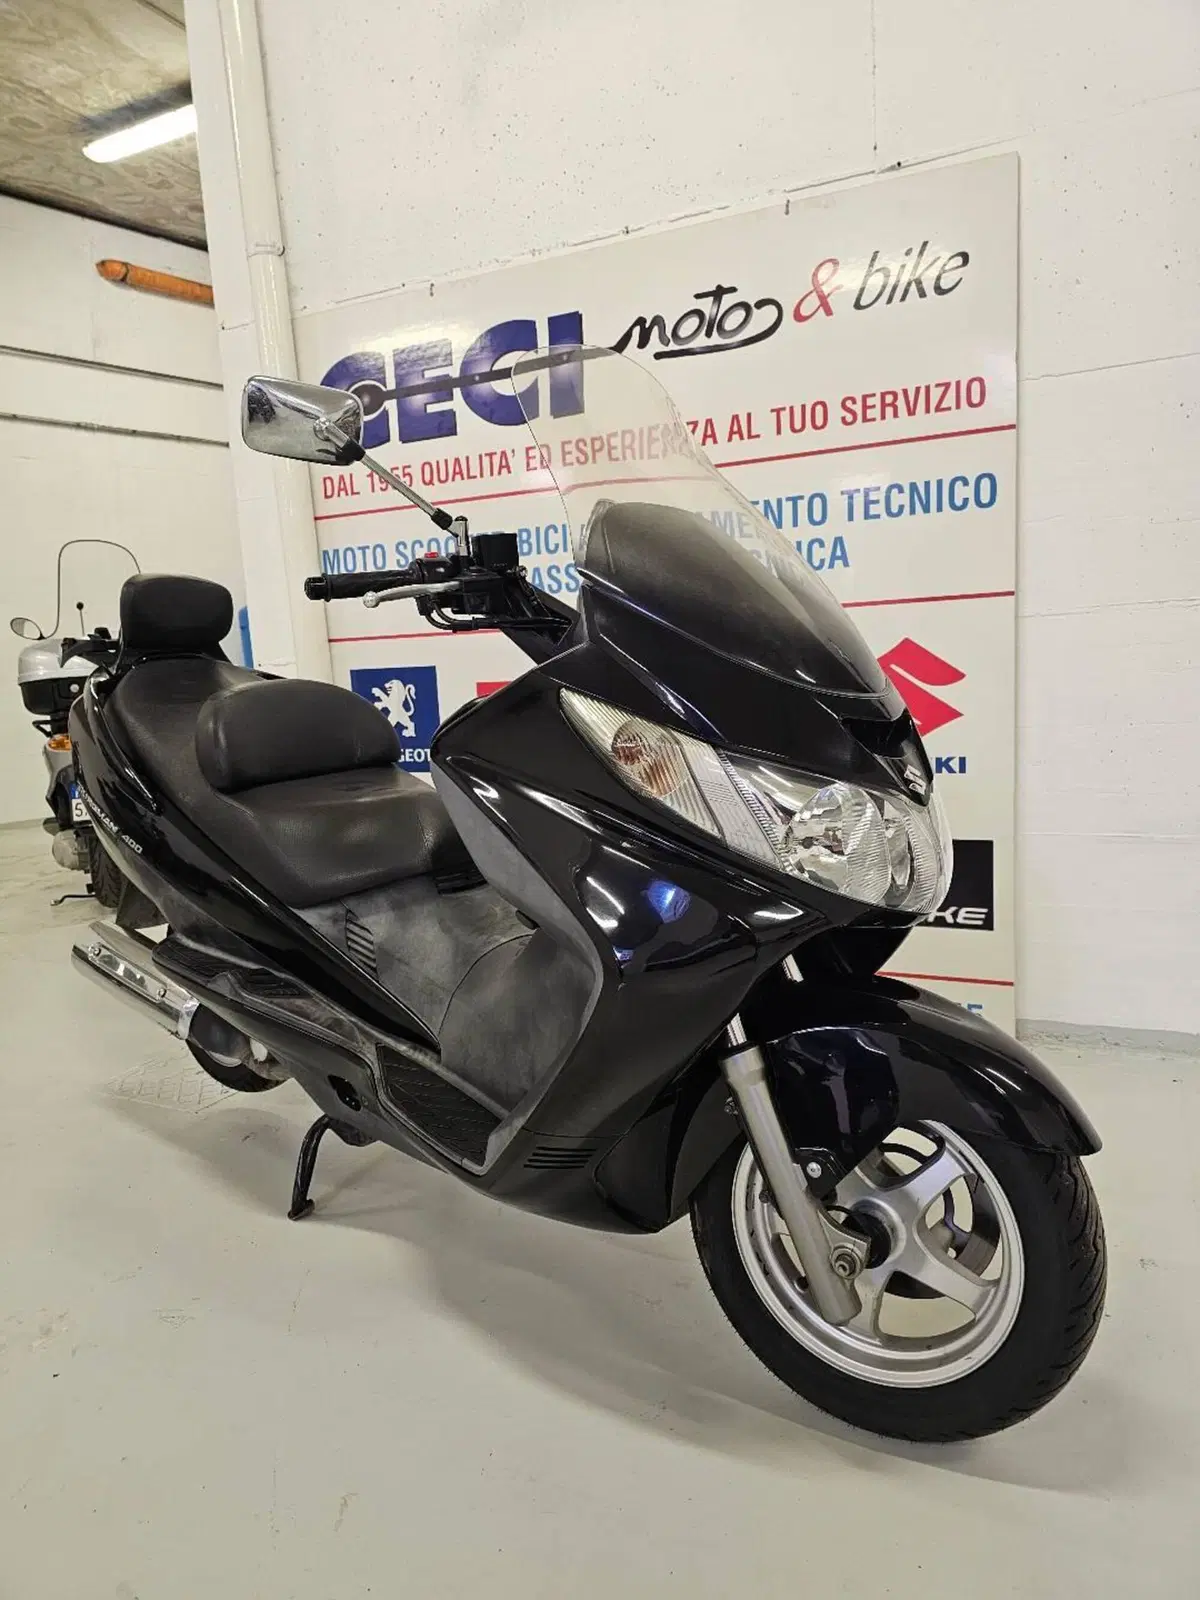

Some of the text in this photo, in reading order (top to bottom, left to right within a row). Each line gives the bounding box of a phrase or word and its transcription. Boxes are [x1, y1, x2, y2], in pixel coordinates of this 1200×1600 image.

[320, 310, 586, 450] CECI
[793, 258, 844, 323] &
[853, 240, 970, 311] bike
[323, 471, 361, 500] DAL
[525, 443, 553, 472] ED
[727, 411, 761, 443] AL
[771, 400, 829, 436] TUO
[840, 376, 987, 427] SERVIZIO
[323, 543, 387, 575] MOTO
[841, 472, 998, 522] TECNICO
[122, 834, 143, 854] 400
